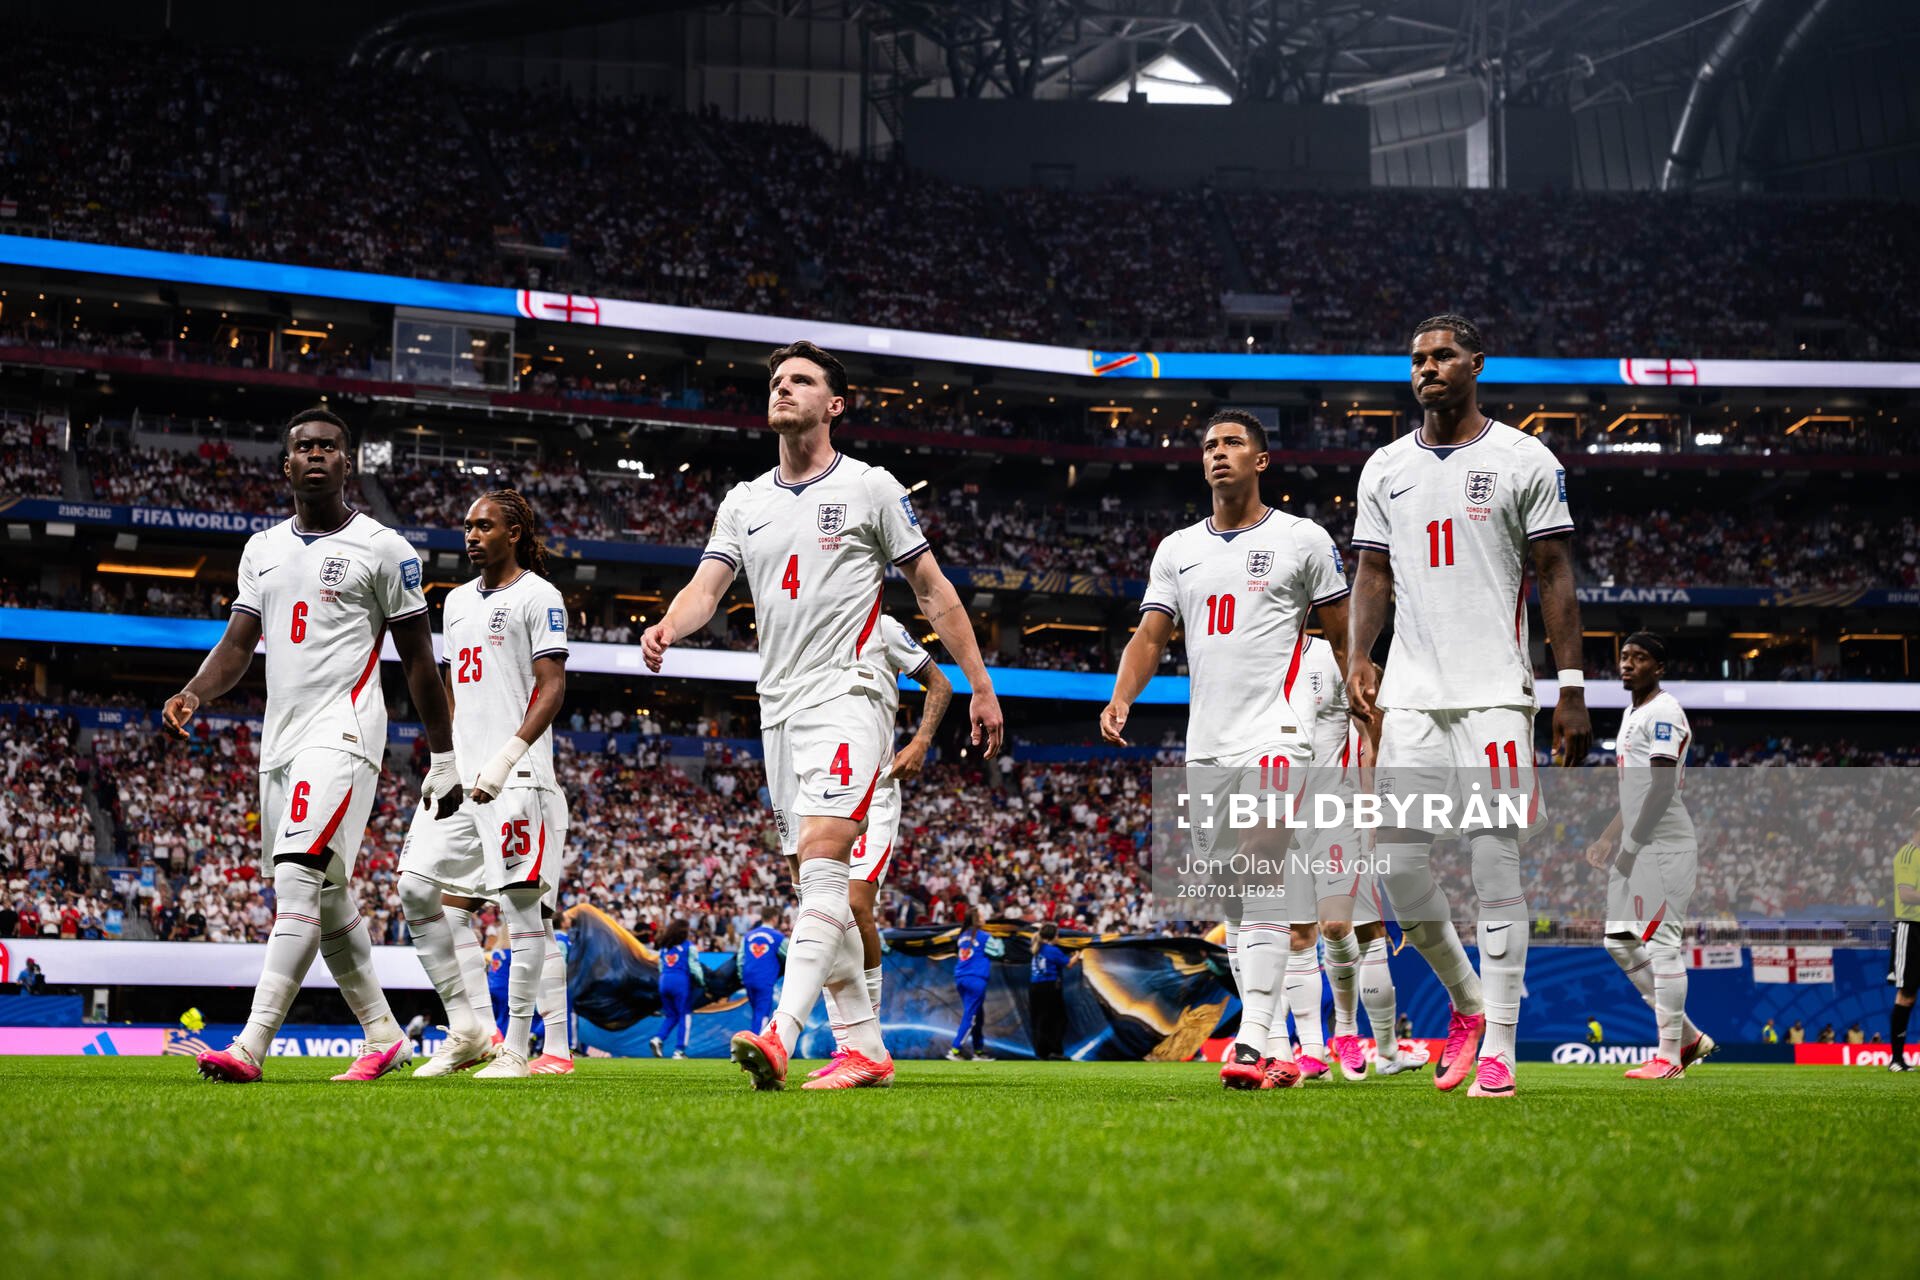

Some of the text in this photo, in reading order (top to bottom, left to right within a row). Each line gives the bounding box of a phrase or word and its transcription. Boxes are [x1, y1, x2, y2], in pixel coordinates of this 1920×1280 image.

[132, 508, 283, 532] FIFA WORLD CU
[1426, 518, 1454, 567] 11
[782, 554, 800, 599] 4
[1575, 588, 1690, 602] ATLANTA
[291, 601, 309, 643] 6
[1206, 594, 1236, 635] 10
[458, 646, 482, 683] 25
[830, 743, 852, 786] 4
[1259, 755, 1289, 792] 10
[1484, 740, 1519, 790] 11
[291, 781, 311, 823] 6
[501, 820, 531, 858] 25
[305, 1038, 365, 1057] WOR
[1842, 1045, 1920, 1067] Lenv
